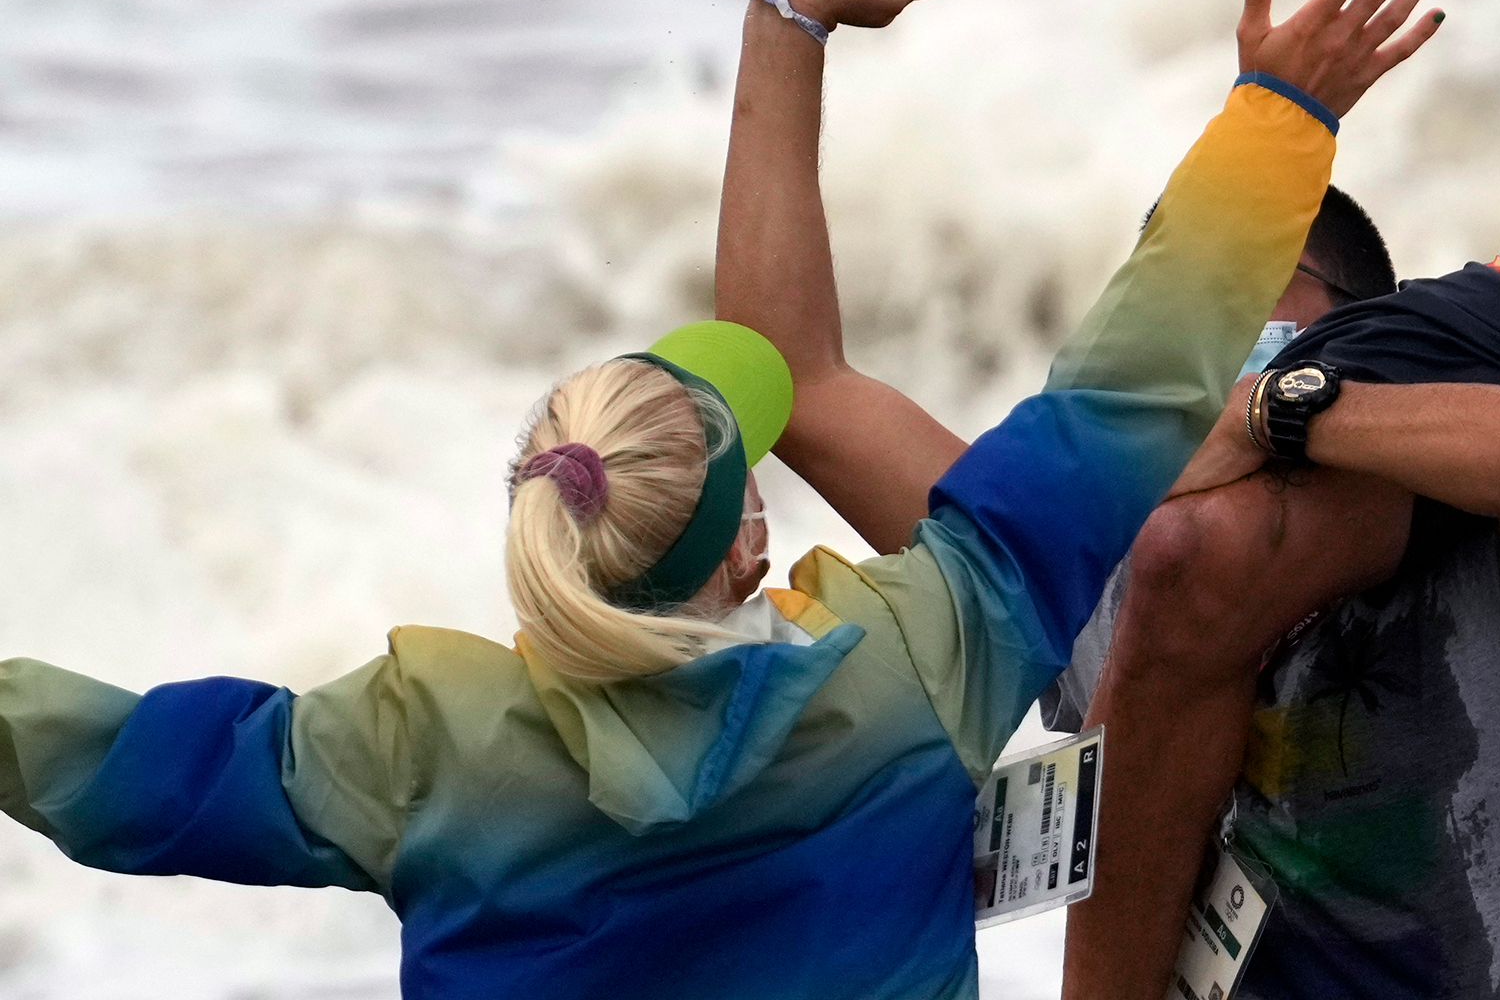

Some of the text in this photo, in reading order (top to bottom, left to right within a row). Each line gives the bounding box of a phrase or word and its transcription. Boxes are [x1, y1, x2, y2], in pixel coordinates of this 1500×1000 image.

[1074, 750, 1094, 873] A 2 R
